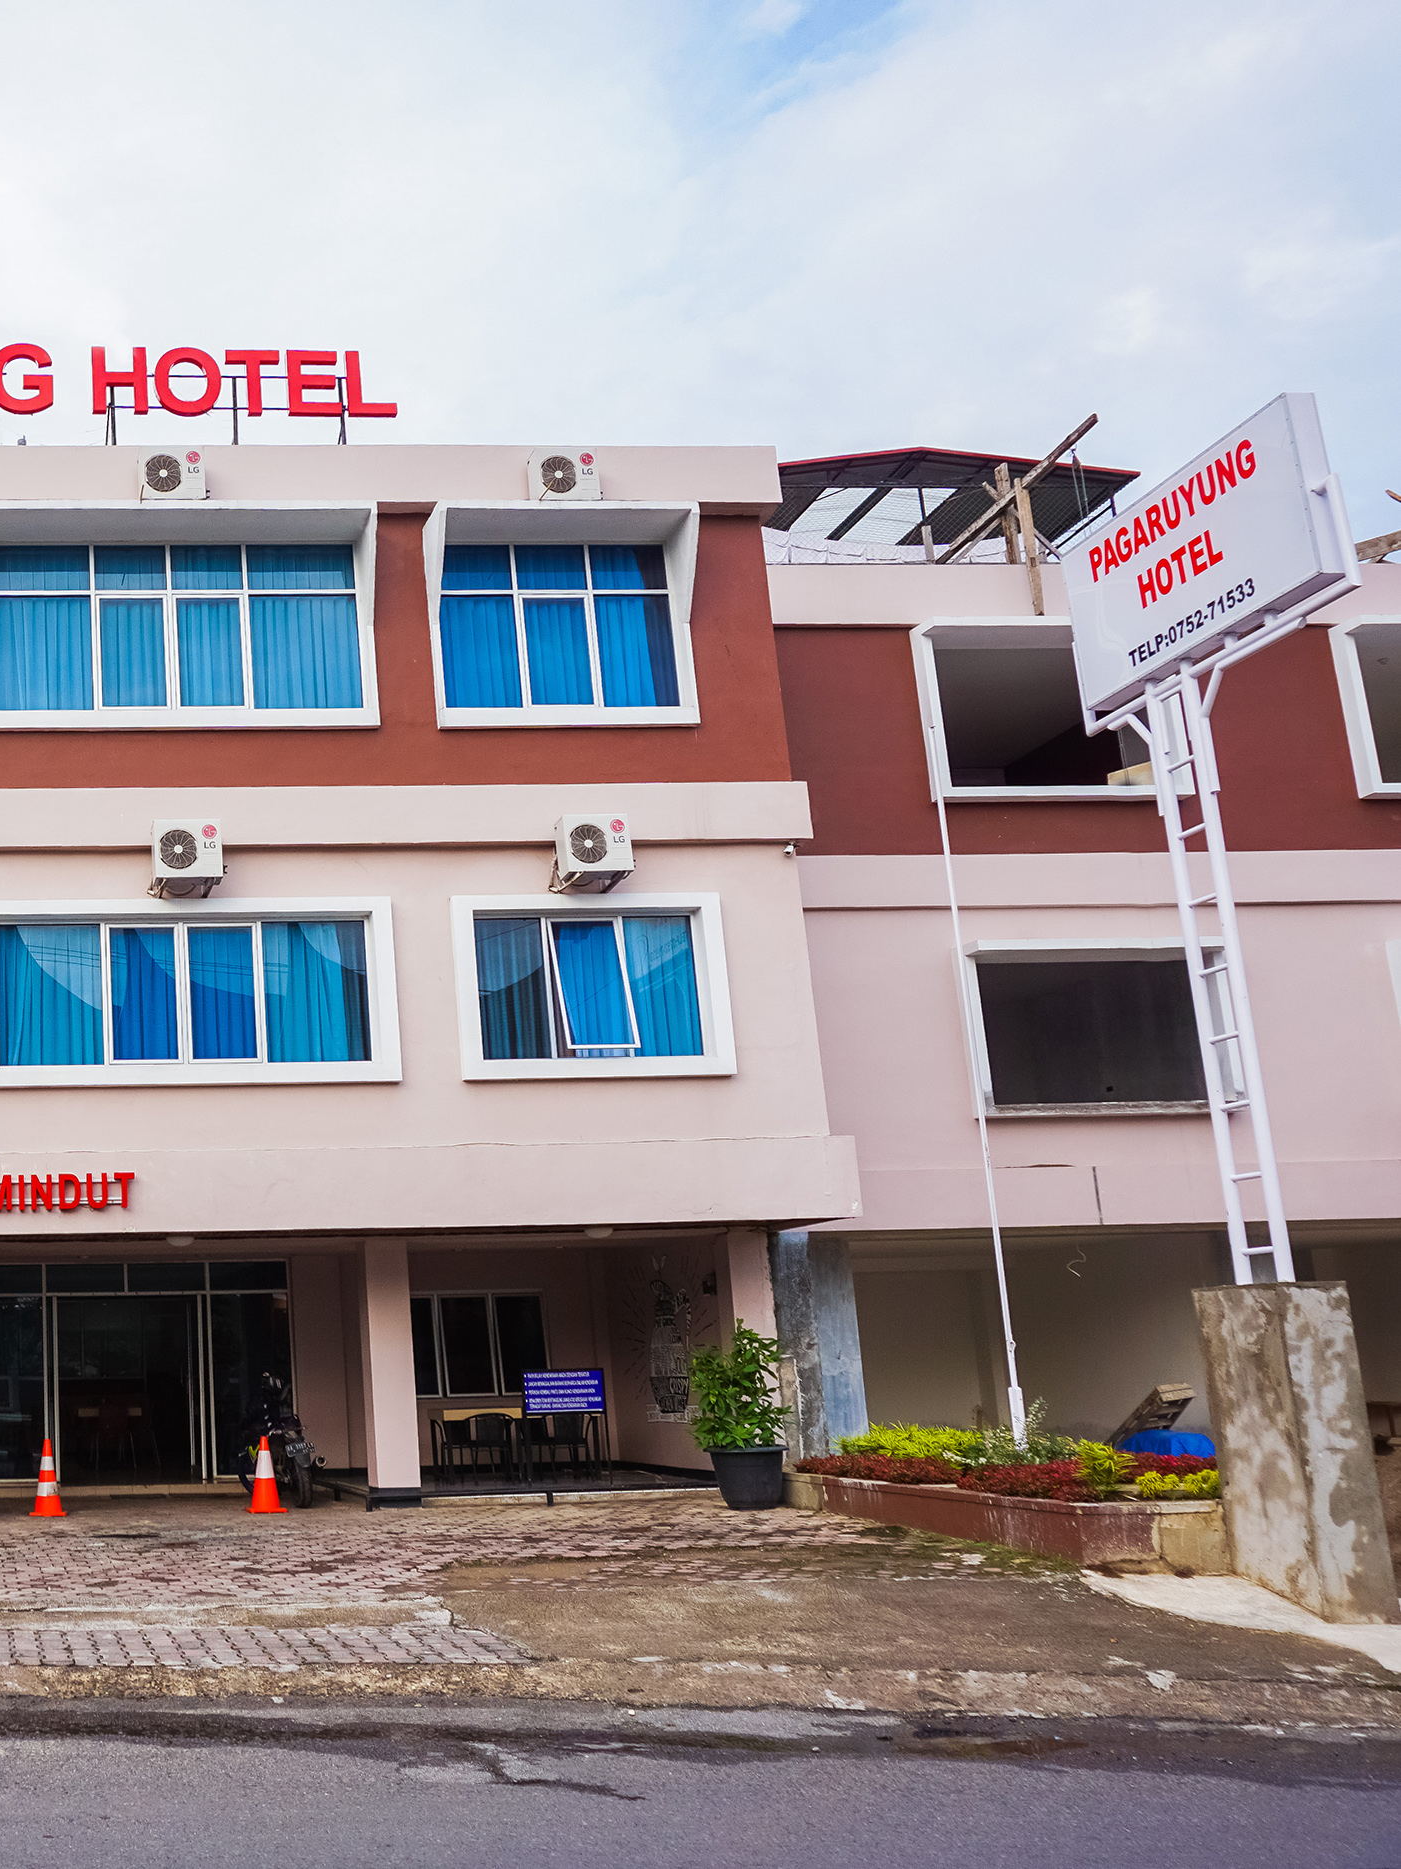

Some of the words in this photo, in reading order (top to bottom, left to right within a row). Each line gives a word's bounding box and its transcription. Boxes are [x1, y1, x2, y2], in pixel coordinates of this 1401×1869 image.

[91, 346, 398, 418] HOTEL
[581, 467, 593, 475] LG
[1088, 439, 1257, 583] PAGARUYUNG
[1137, 529, 1224, 609] HOTEL
[1128, 577, 1256, 667] TELP:0752-71533
[613, 835, 625, 843] LG
